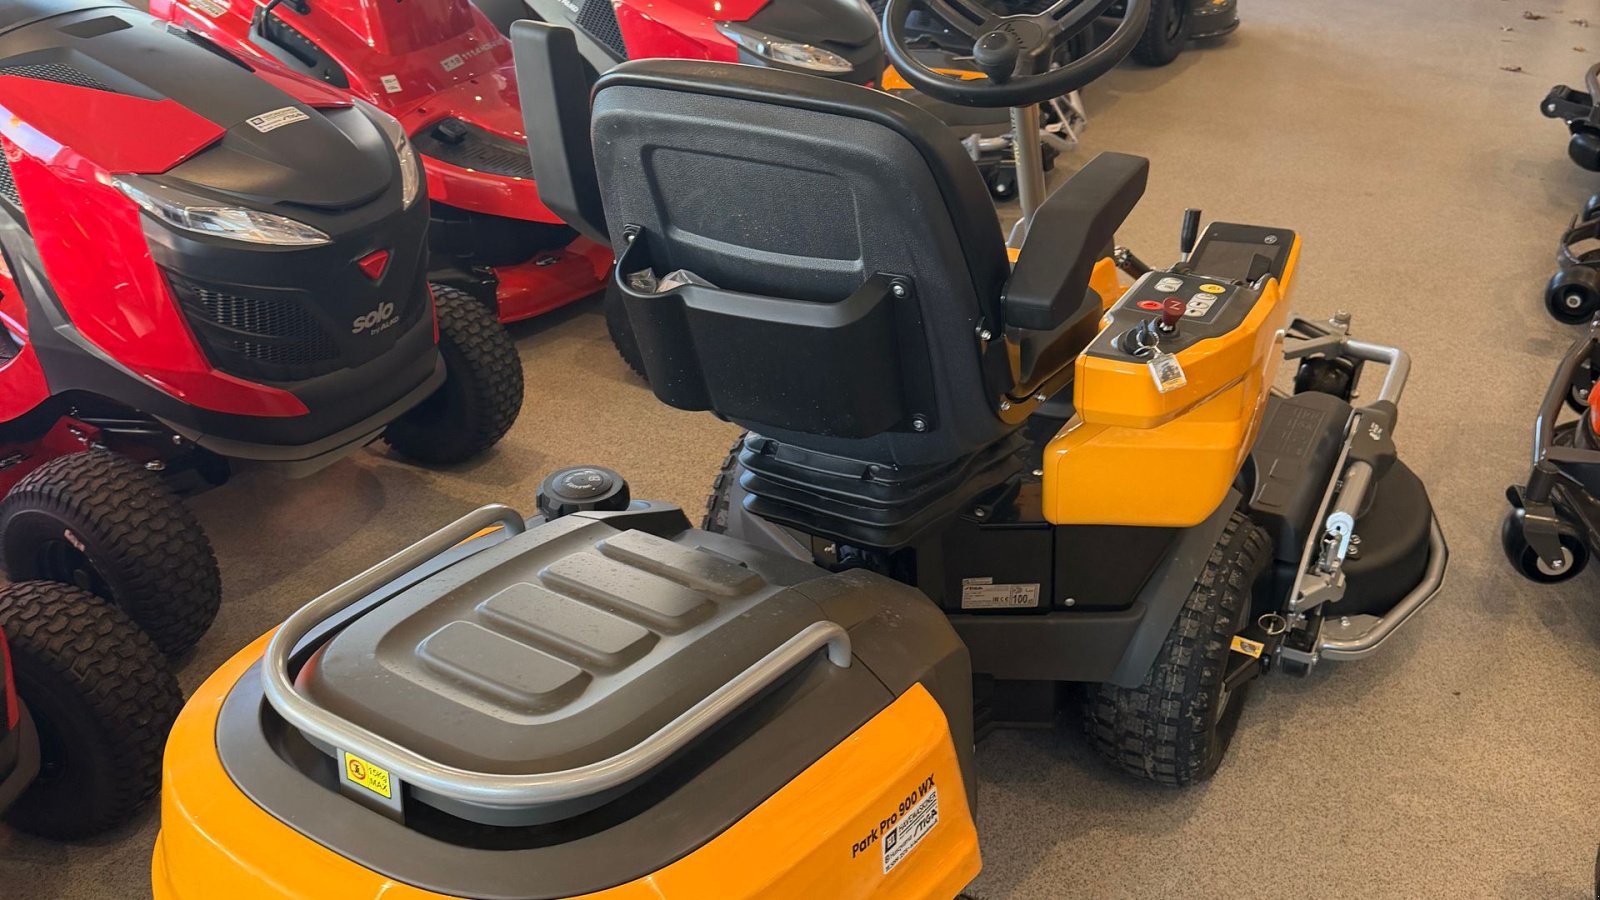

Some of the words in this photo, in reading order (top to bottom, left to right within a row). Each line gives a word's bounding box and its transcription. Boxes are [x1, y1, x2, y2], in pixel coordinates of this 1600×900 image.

[352, 302, 394, 334] solo
[1012, 594, 1028, 604] 100
[852, 828, 878, 859] Park
[879, 812, 897, 835] Pro
[898, 791, 917, 816] 900
[918, 773, 934, 796] WX
